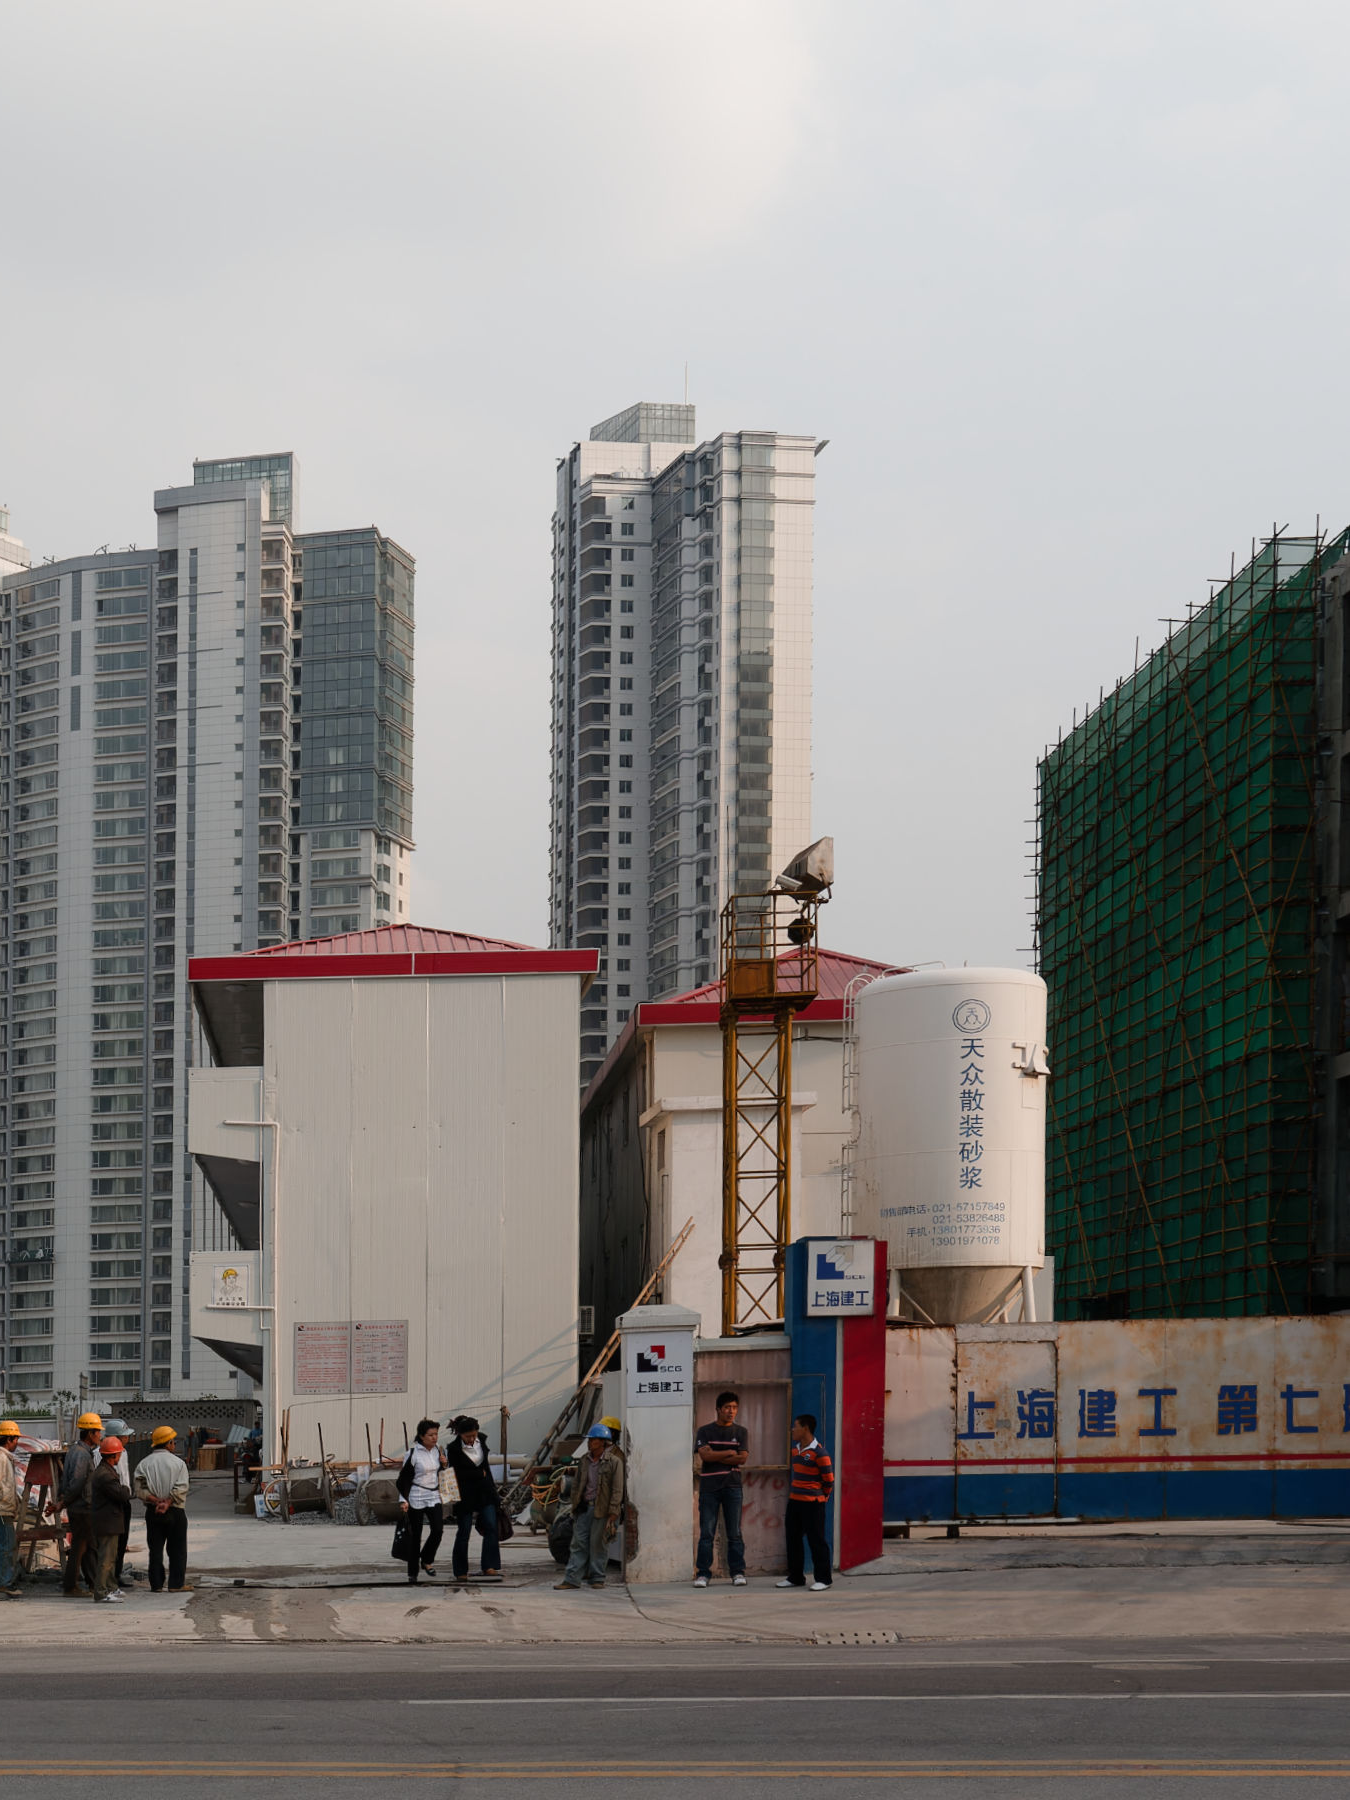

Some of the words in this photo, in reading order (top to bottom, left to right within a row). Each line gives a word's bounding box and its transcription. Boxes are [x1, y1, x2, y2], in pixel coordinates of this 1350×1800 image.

[958, 1038, 985, 1190] 天众散装砂浆
[811, 1290, 870, 1307] 上海建工
[659, 1365, 683, 1373] SCG
[635, 1381, 685, 1394] 上海建工
[958, 1384, 1350, 1440] 上海建工第七
